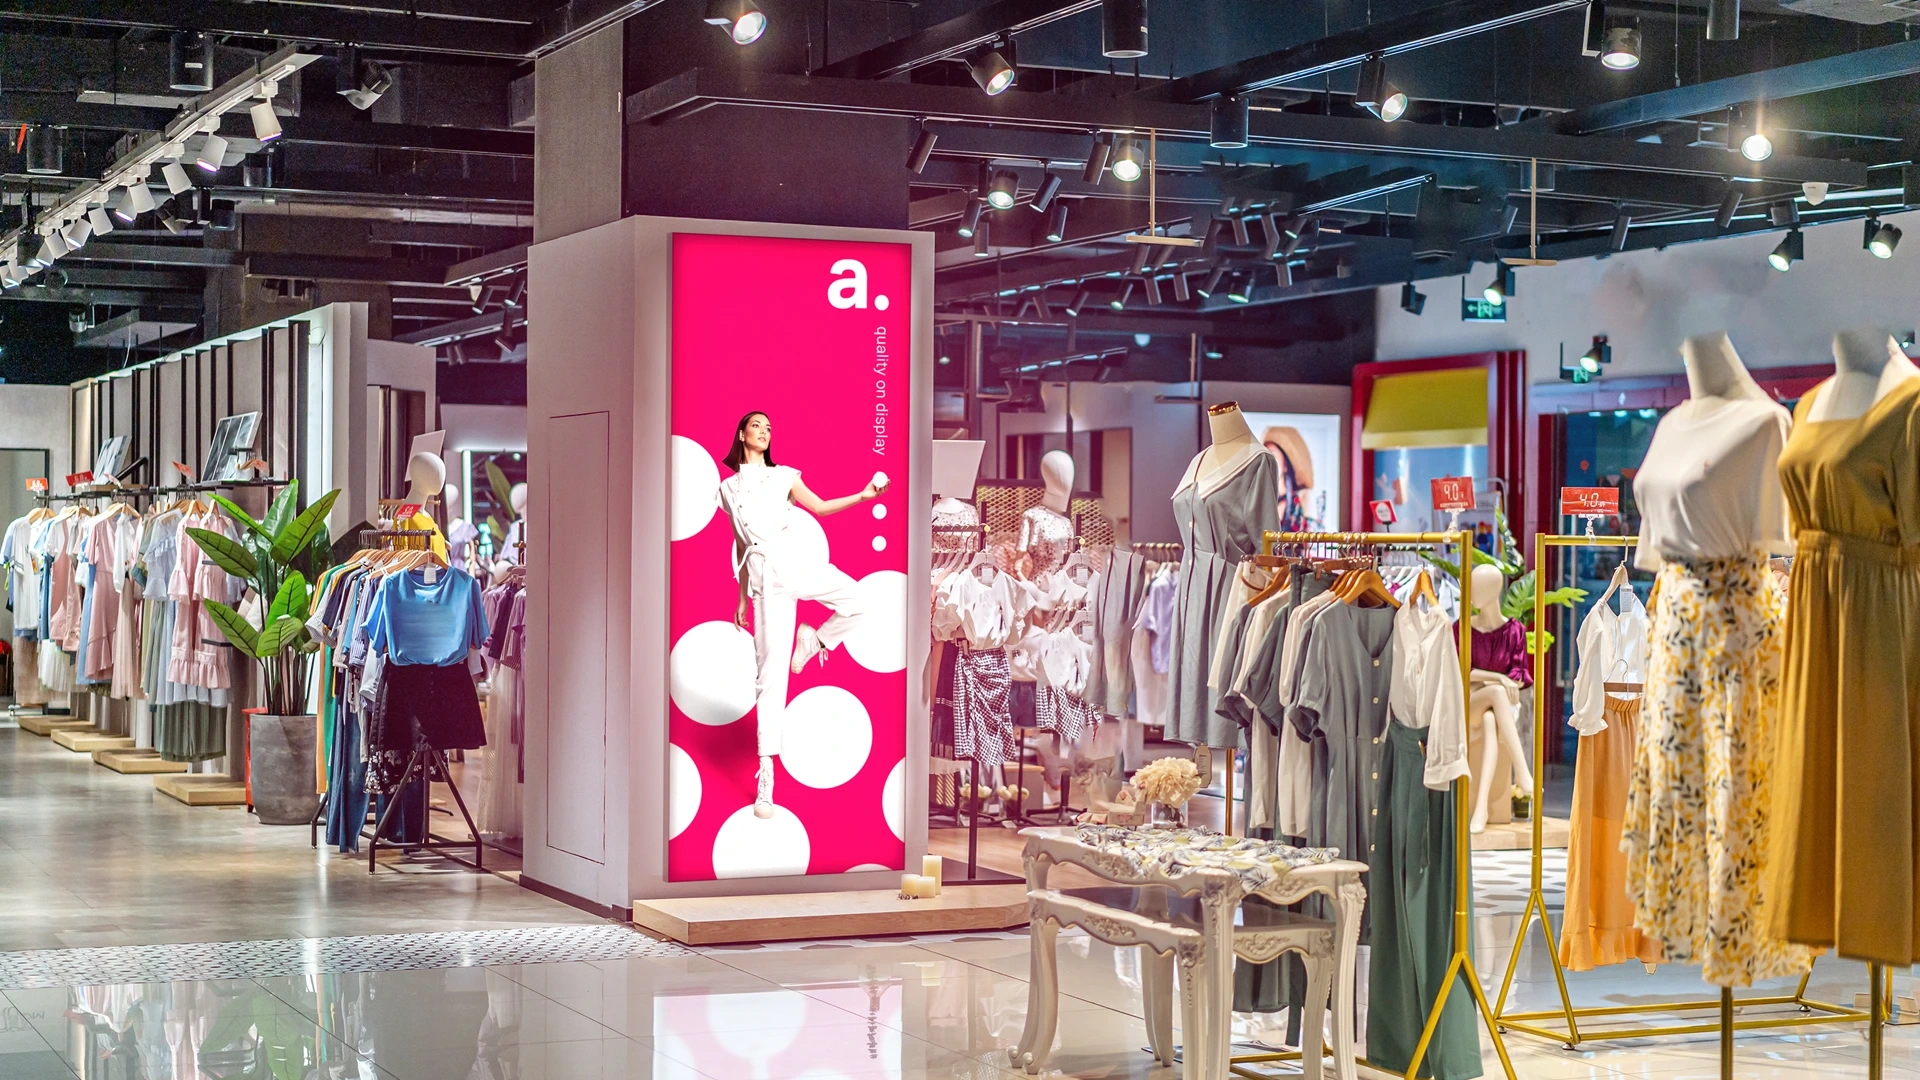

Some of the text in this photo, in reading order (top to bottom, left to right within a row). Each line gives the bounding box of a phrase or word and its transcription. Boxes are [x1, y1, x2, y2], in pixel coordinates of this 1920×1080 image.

[827, 258, 890, 311] a.
[873, 326, 889, 456] quality on display
